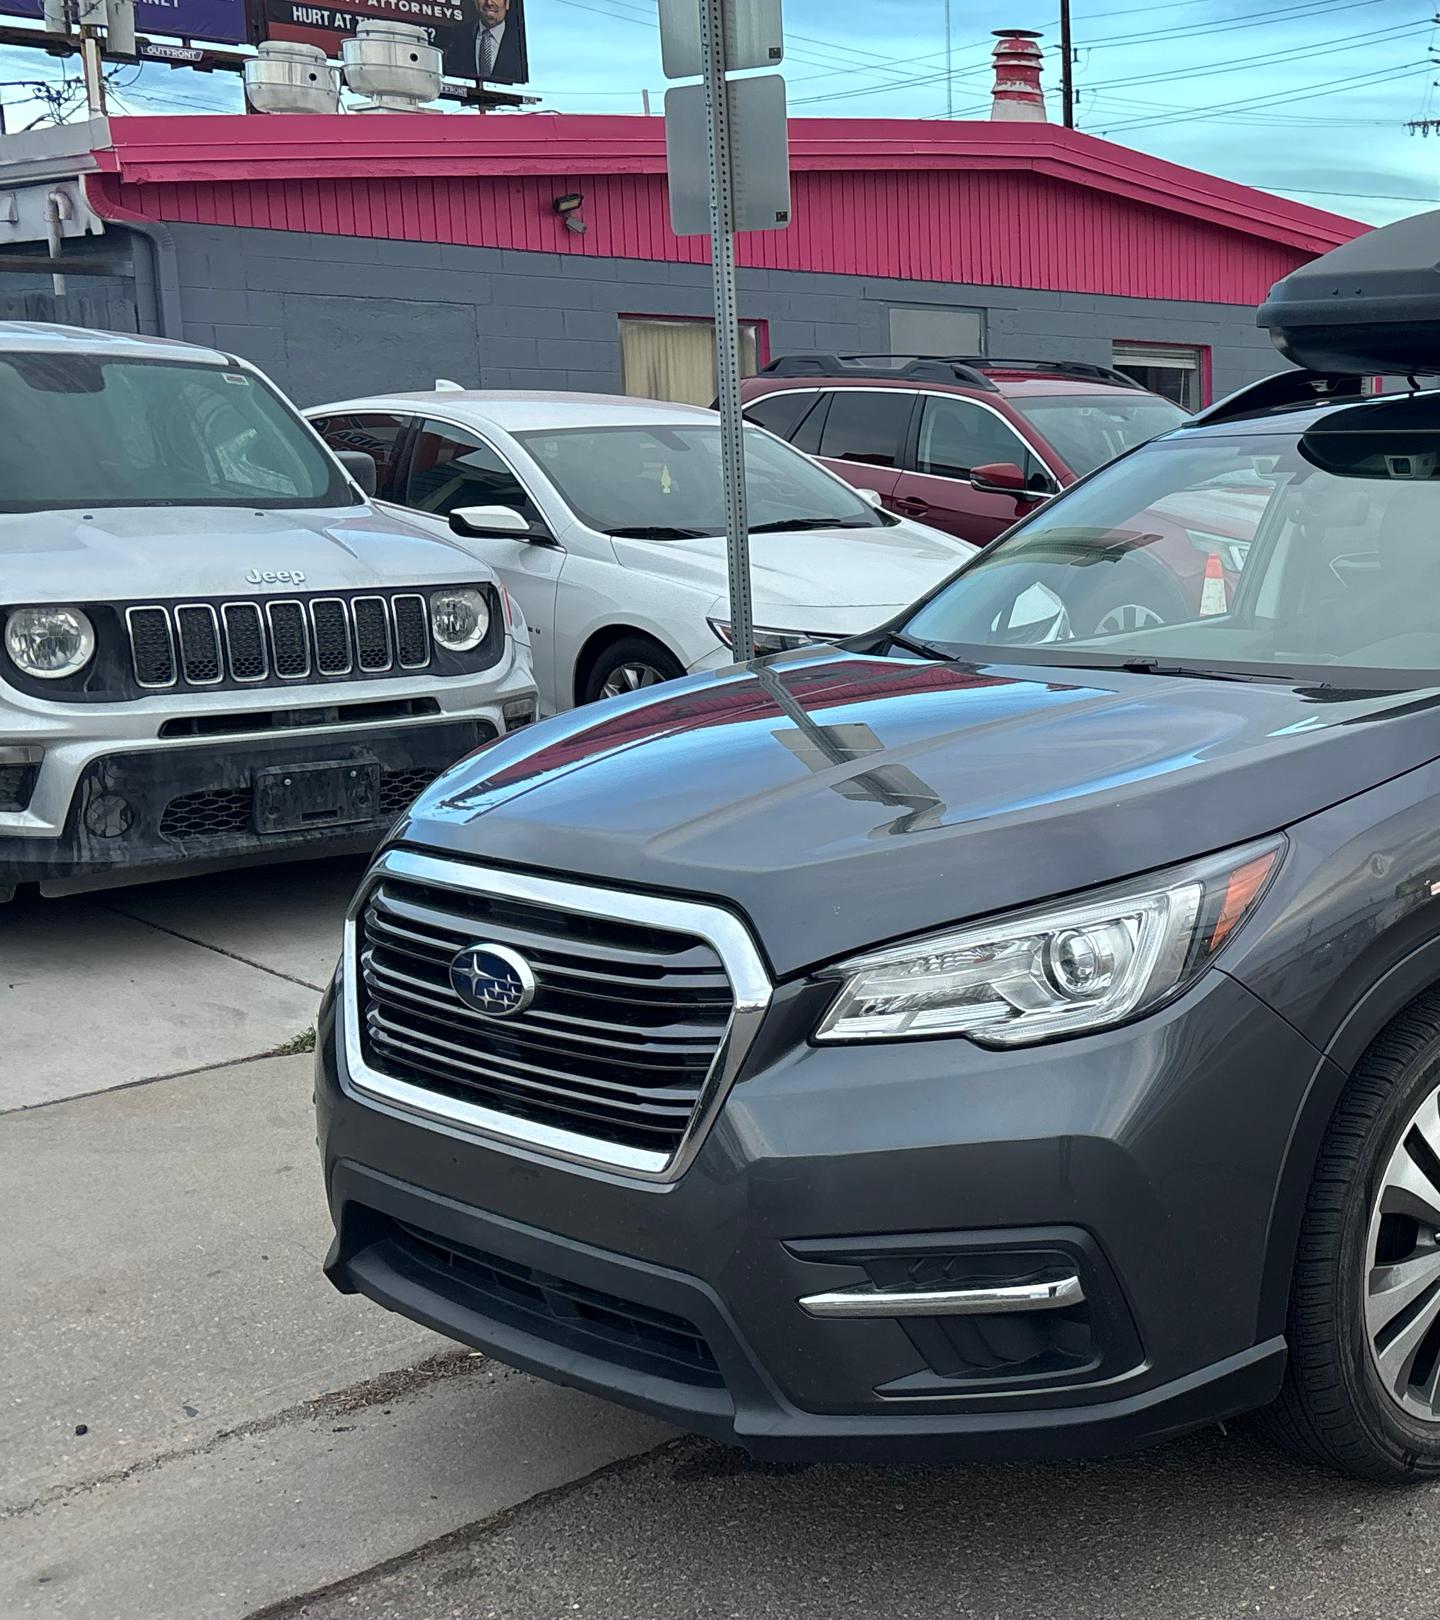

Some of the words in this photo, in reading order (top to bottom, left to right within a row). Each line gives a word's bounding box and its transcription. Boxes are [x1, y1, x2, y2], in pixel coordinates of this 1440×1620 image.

[292, 6, 330, 26] HURT
[334, 13, 352, 30] AT
[367, 0, 463, 21] ATTORNEYS
[146, 45, 197, 60] OUTFRONT
[245, 568, 305, 585] Jeep
